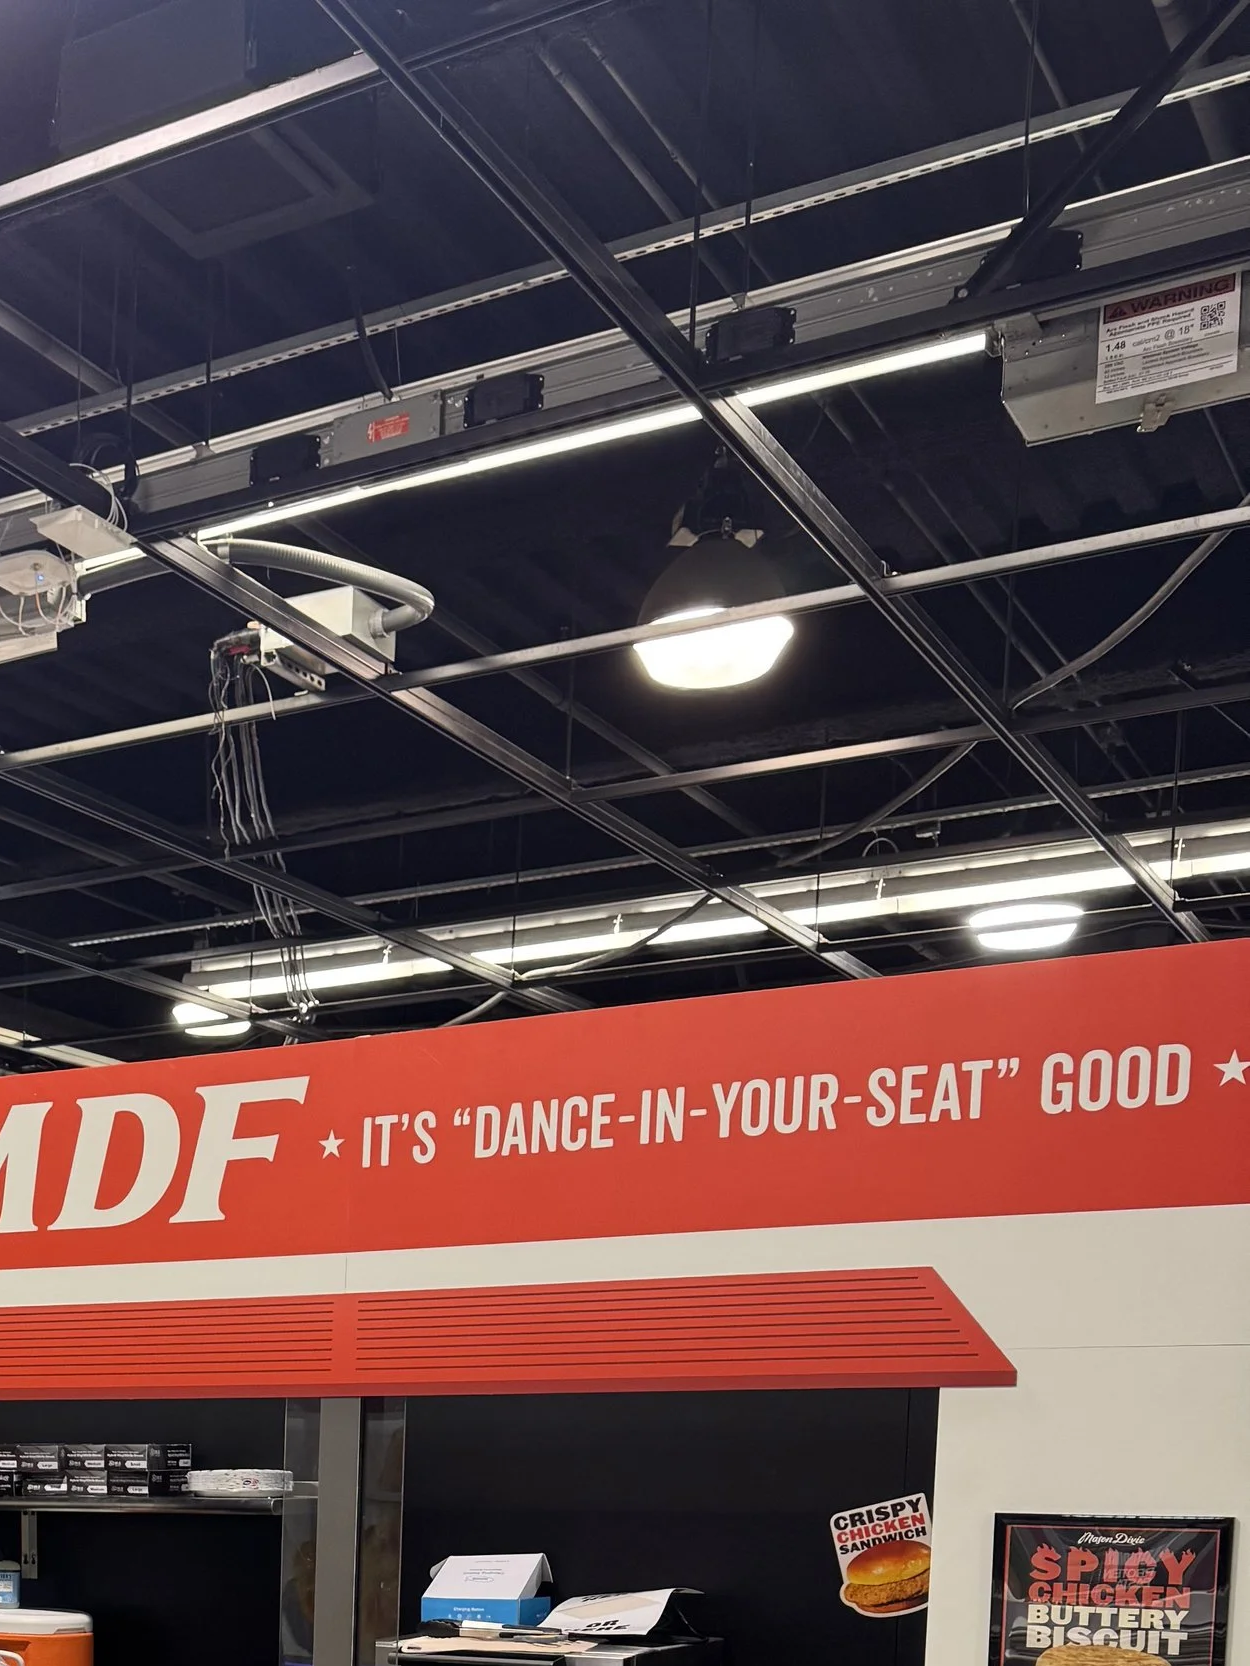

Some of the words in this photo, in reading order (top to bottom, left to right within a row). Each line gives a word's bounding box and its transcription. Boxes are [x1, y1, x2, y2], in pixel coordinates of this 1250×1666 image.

[1131, 279, 1230, 313] WARNING
[1106, 340, 1126, 352] 1.48
[1164, 328, 1176, 340] @
[361, 1108, 437, 1169] IT'S
[1040, 1043, 1192, 1115] GOOD
[834, 1496, 922, 1531] CRISPY
[837, 1513, 925, 1544] CHICKEN
[839, 1526, 927, 1555] SANDWICH
[1077, 1532, 1115, 1544] Mason
[1114, 1533, 1145, 1545] Dixie
[1029, 1543, 1196, 1585] SPICY
[1028, 1581, 1191, 1609] CHICKEN
[1028, 1604, 1189, 1630] BUTTERY
[1026, 1625, 1188, 1656] BISCUIT
